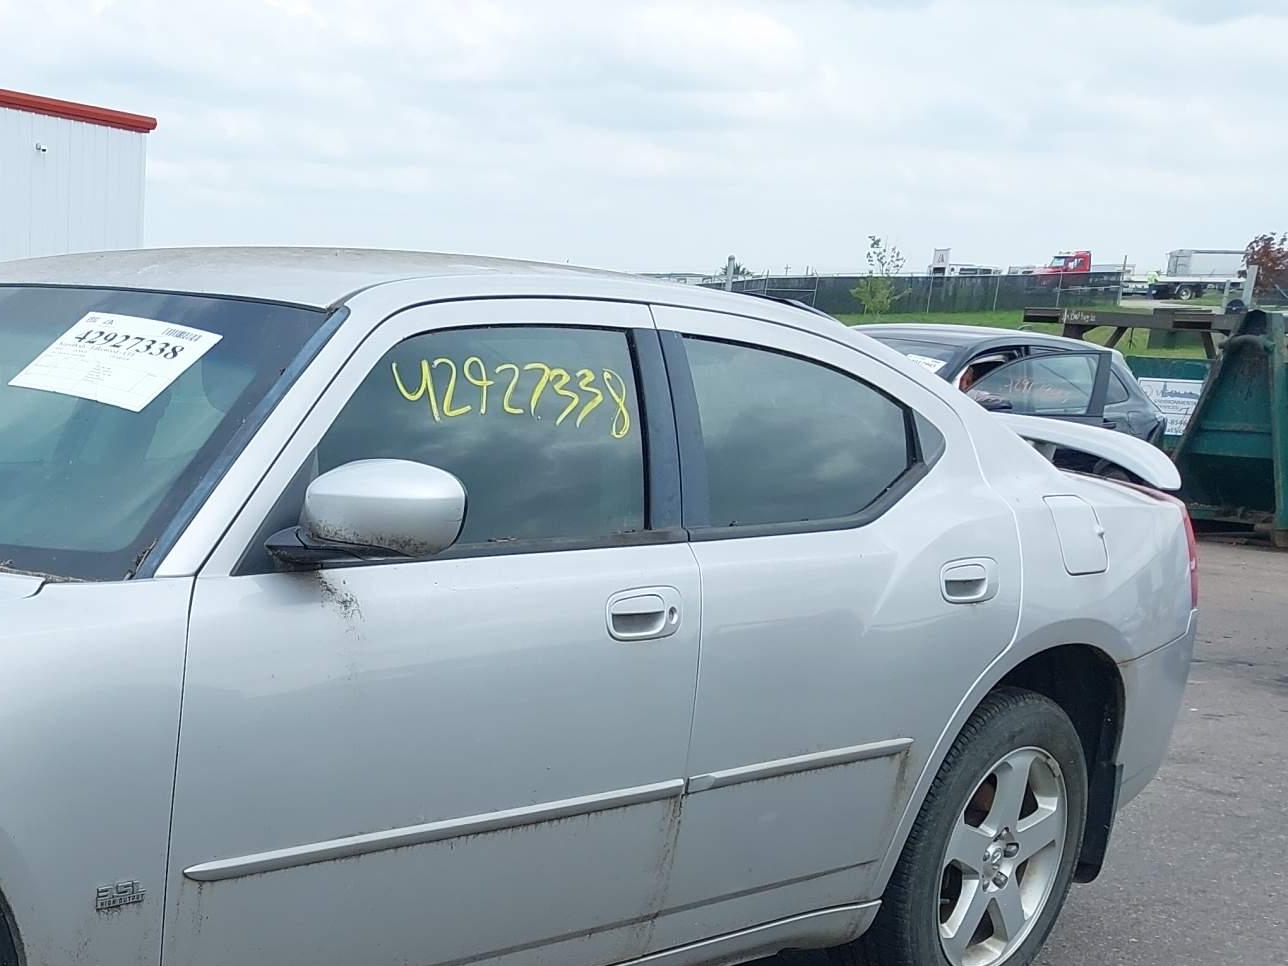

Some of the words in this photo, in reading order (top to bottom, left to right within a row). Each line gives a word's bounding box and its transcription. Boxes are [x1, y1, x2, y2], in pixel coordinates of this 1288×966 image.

[75, 329, 185, 360] 42927338
[392, 356, 630, 439] 42927338
[118, 893, 145, 904] OUTPUT
